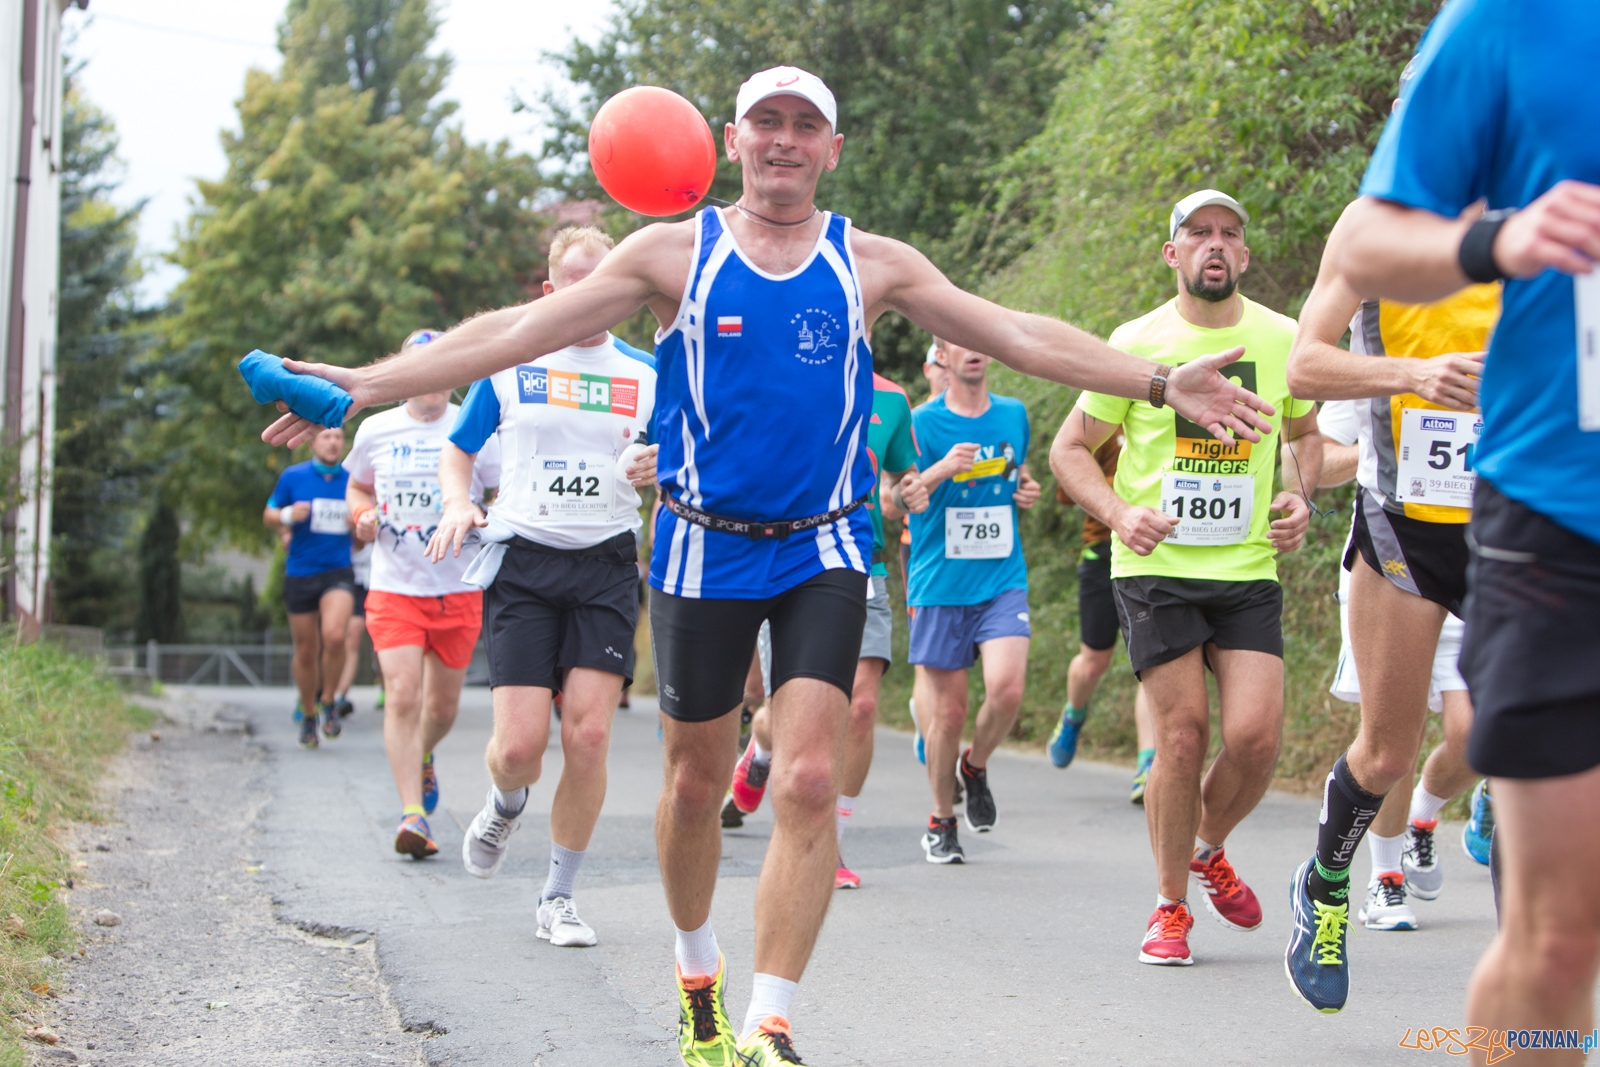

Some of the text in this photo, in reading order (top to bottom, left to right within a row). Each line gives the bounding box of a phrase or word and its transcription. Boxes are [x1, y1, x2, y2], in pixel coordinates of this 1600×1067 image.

[806, 308, 840, 329] MANIAC
[551, 375, 609, 406] ESA
[1191, 439, 1239, 459] night
[1427, 440, 1474, 472] 51
[1174, 457, 1248, 473] runners
[549, 476, 600, 496] 442
[1429, 479, 1441, 488] 39
[1444, 480, 1466, 490] BIEG
[394, 492, 431, 507] 179
[1171, 496, 1241, 520] 1801
[961, 523, 1000, 540] 789
